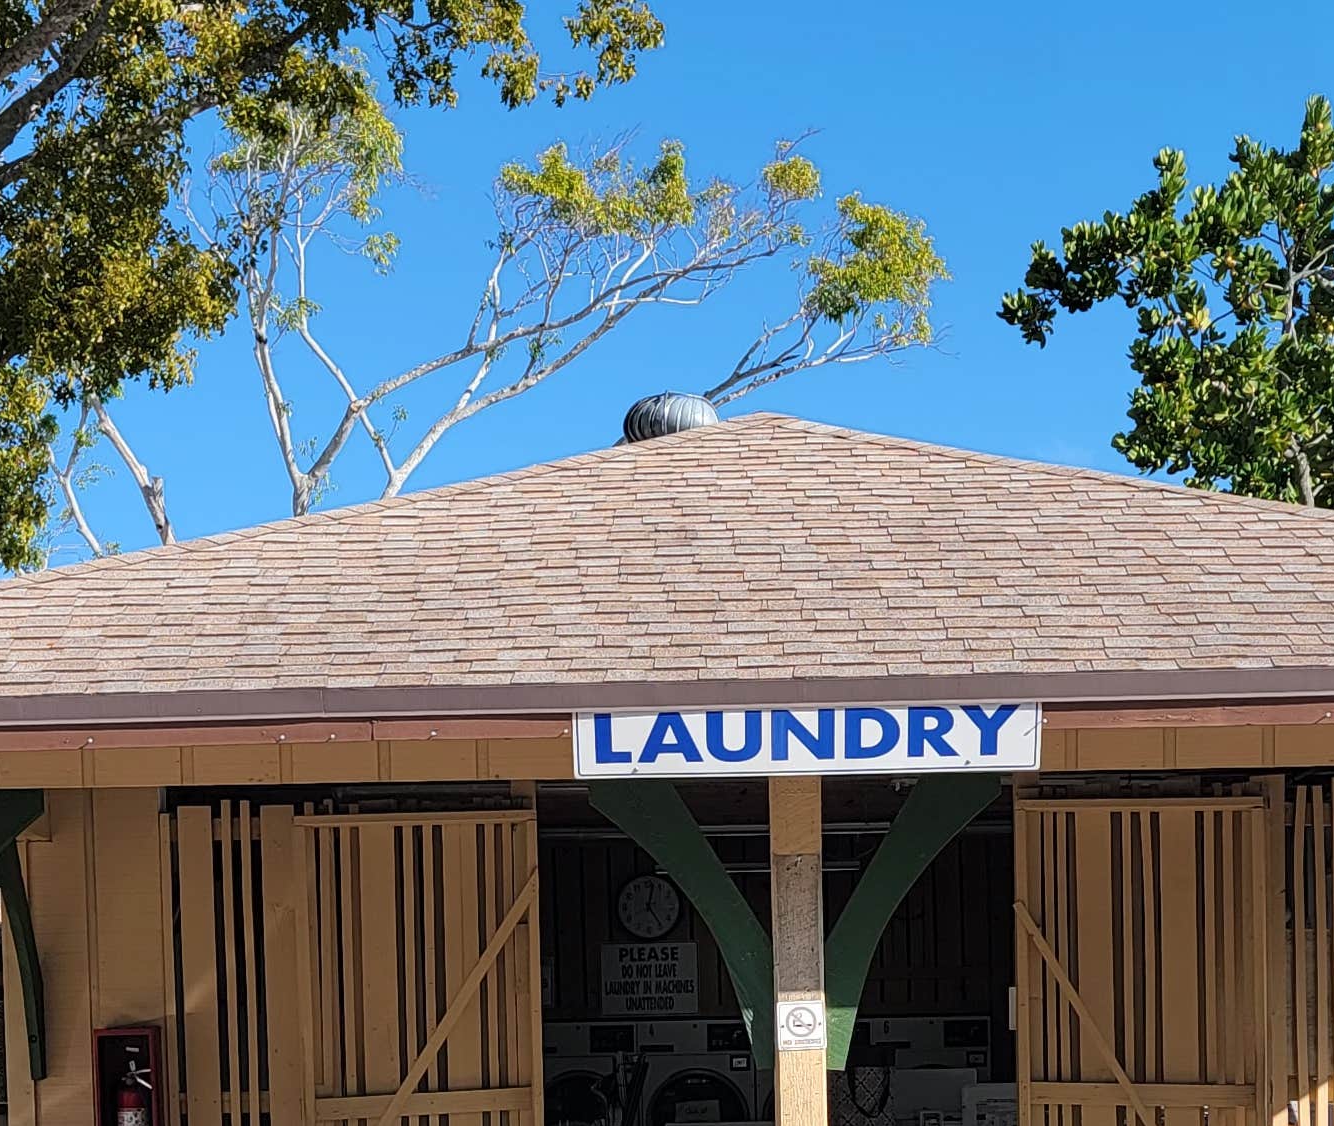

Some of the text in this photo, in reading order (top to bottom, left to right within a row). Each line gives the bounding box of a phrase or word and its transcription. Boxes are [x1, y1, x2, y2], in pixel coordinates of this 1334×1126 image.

[593, 703, 1022, 764] LAUNDRY
[618, 946, 679, 962] PLEASE
[621, 963, 677, 978] DO NOT LEAVE
[604, 979, 695, 996] LAUNDRY IN MACHINES
[625, 997, 675, 1011] UNATTENDED
